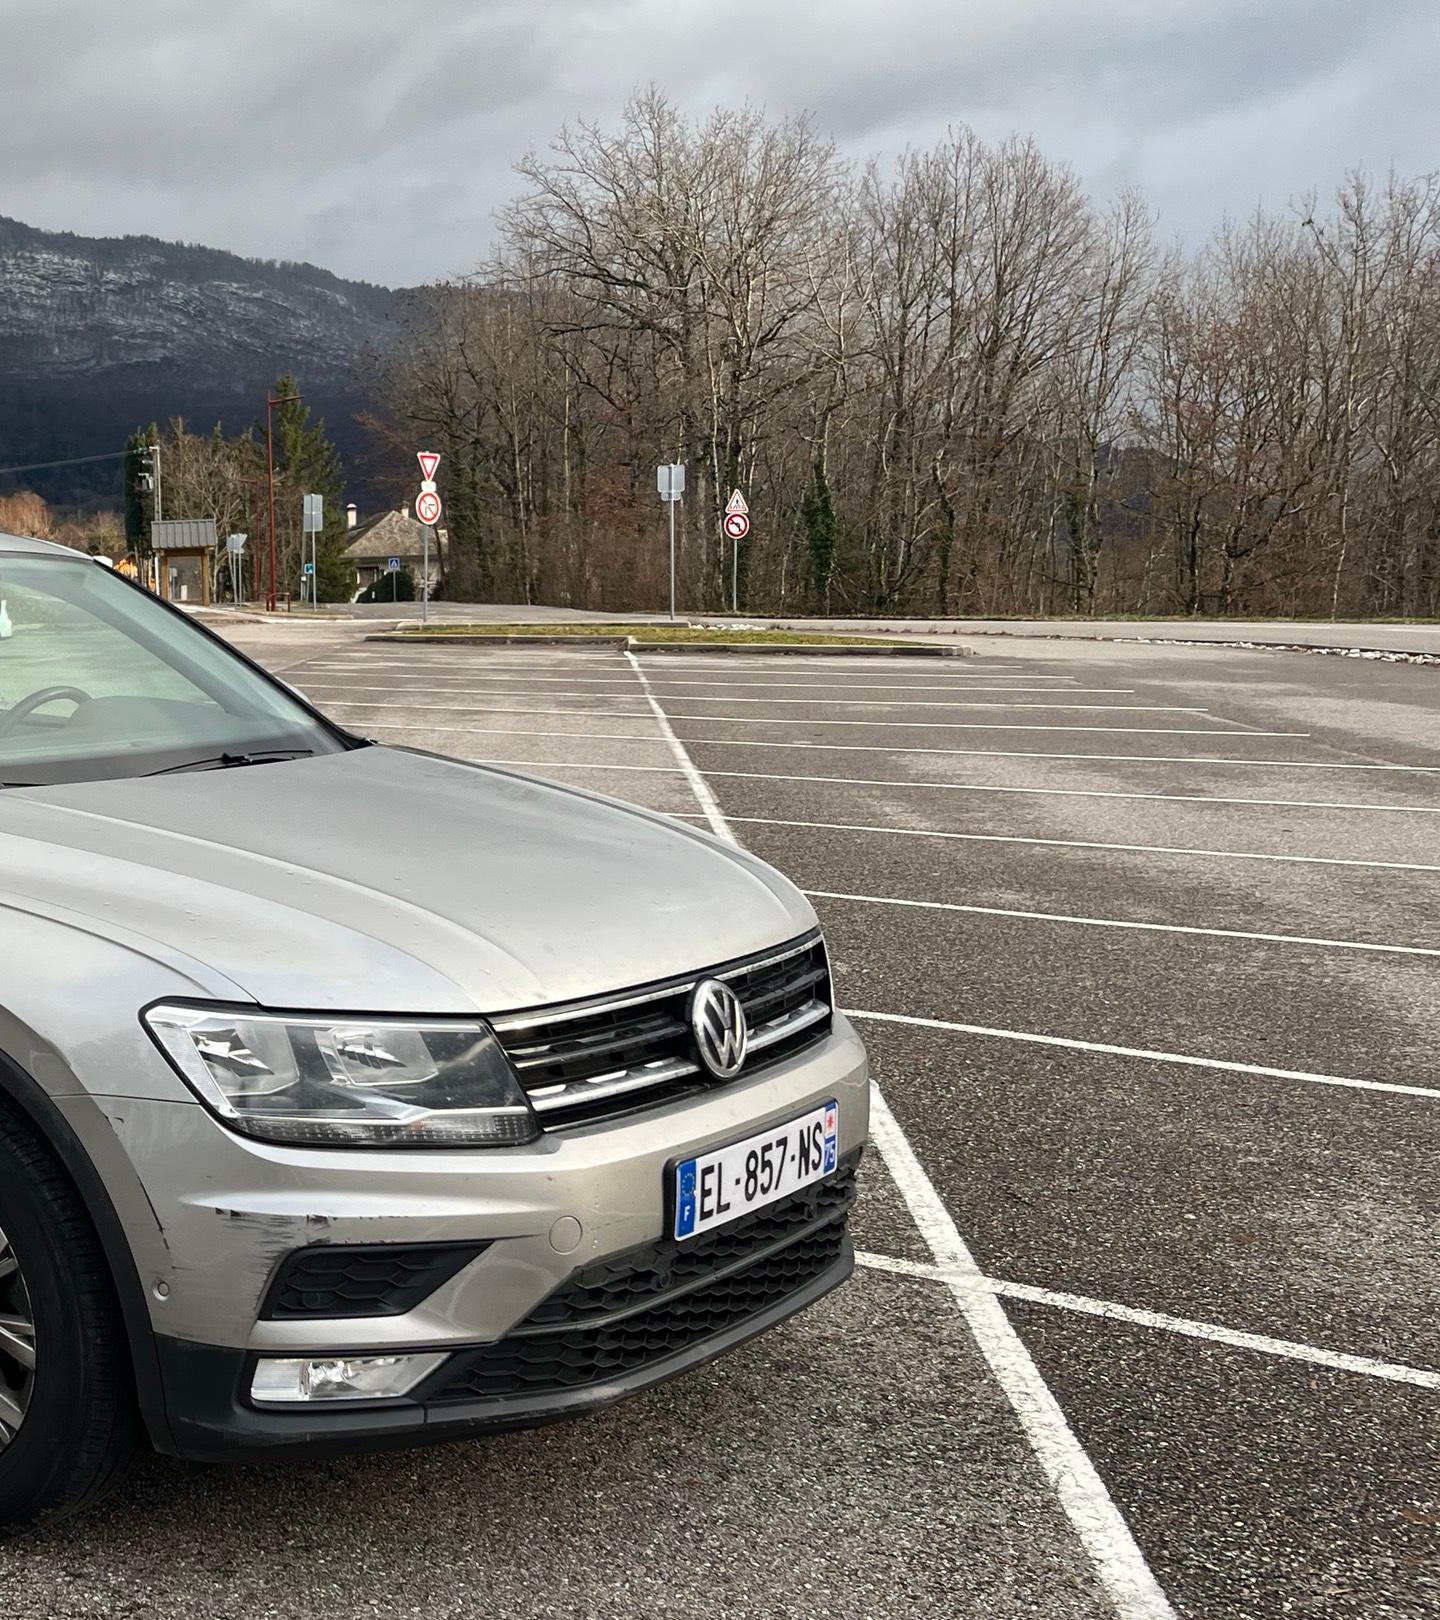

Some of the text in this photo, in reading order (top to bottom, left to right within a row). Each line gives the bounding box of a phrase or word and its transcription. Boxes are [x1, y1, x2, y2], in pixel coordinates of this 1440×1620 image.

[683, 1121, 835, 1221] F EL-857-NS 75
